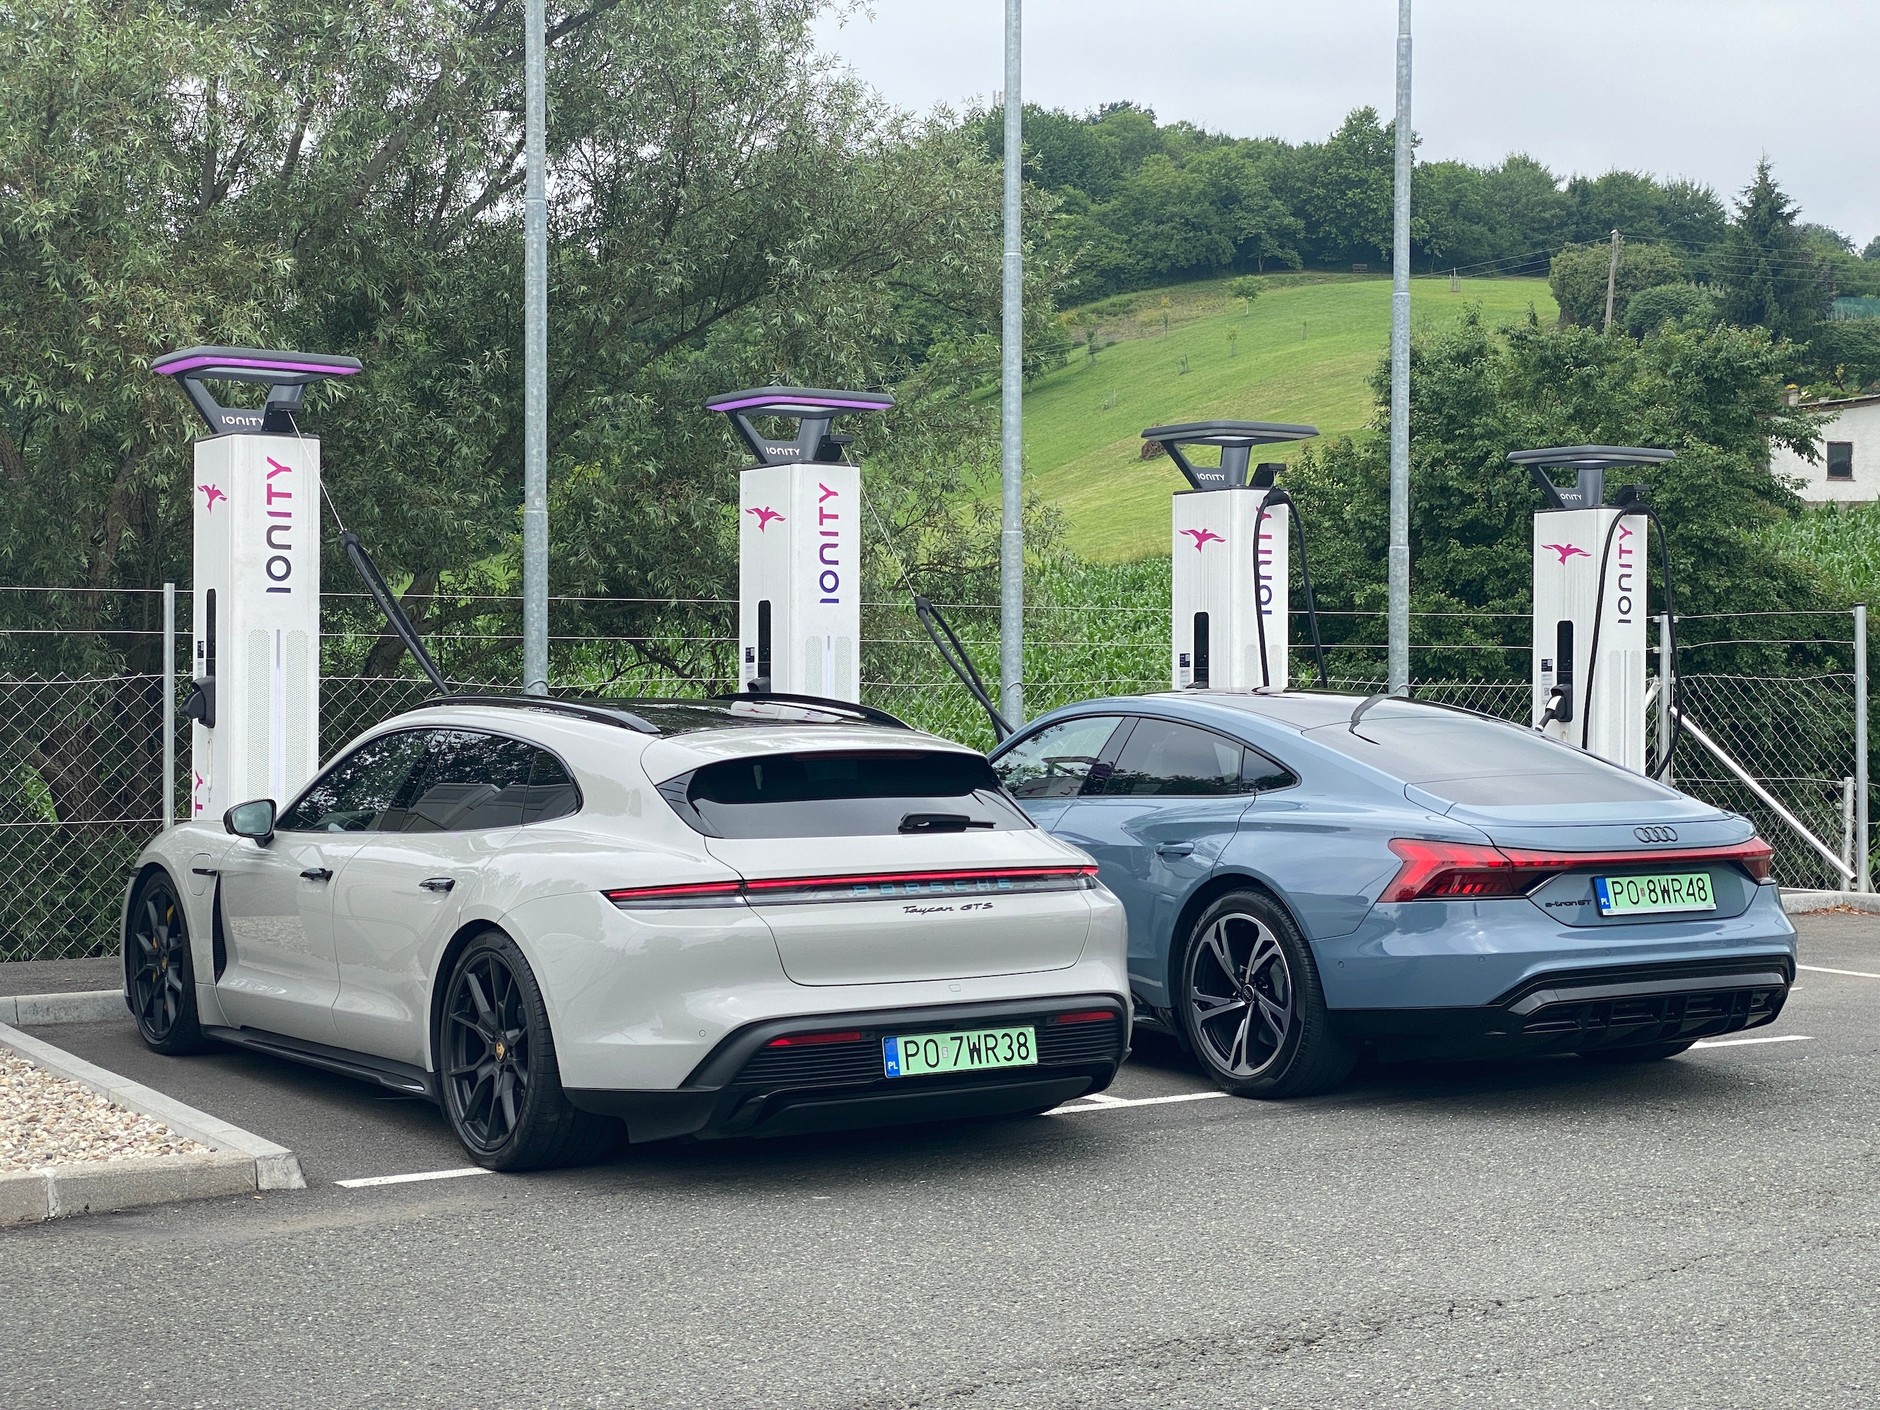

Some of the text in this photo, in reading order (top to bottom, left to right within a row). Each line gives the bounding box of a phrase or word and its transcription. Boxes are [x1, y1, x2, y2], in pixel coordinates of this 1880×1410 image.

[221, 415, 265, 427] IONITY
[765, 446, 801, 456] IONITY
[1196, 472, 1225, 481] IONITY
[1559, 493, 1582, 501] ONITY
[266, 455, 293, 594] IONITY
[818, 482, 840, 604] IONITY
[1617, 523, 1634, 624] IONITY
[852, 879, 1010, 895] PORSCHE
[1611, 877, 1708, 906] PO 8WR48
[1600, 897, 1609, 906] PL
[903, 902, 993, 916] Taycan GTS
[903, 1031, 1030, 1071] PO 7WR38
[887, 1061, 898, 1070] PL
